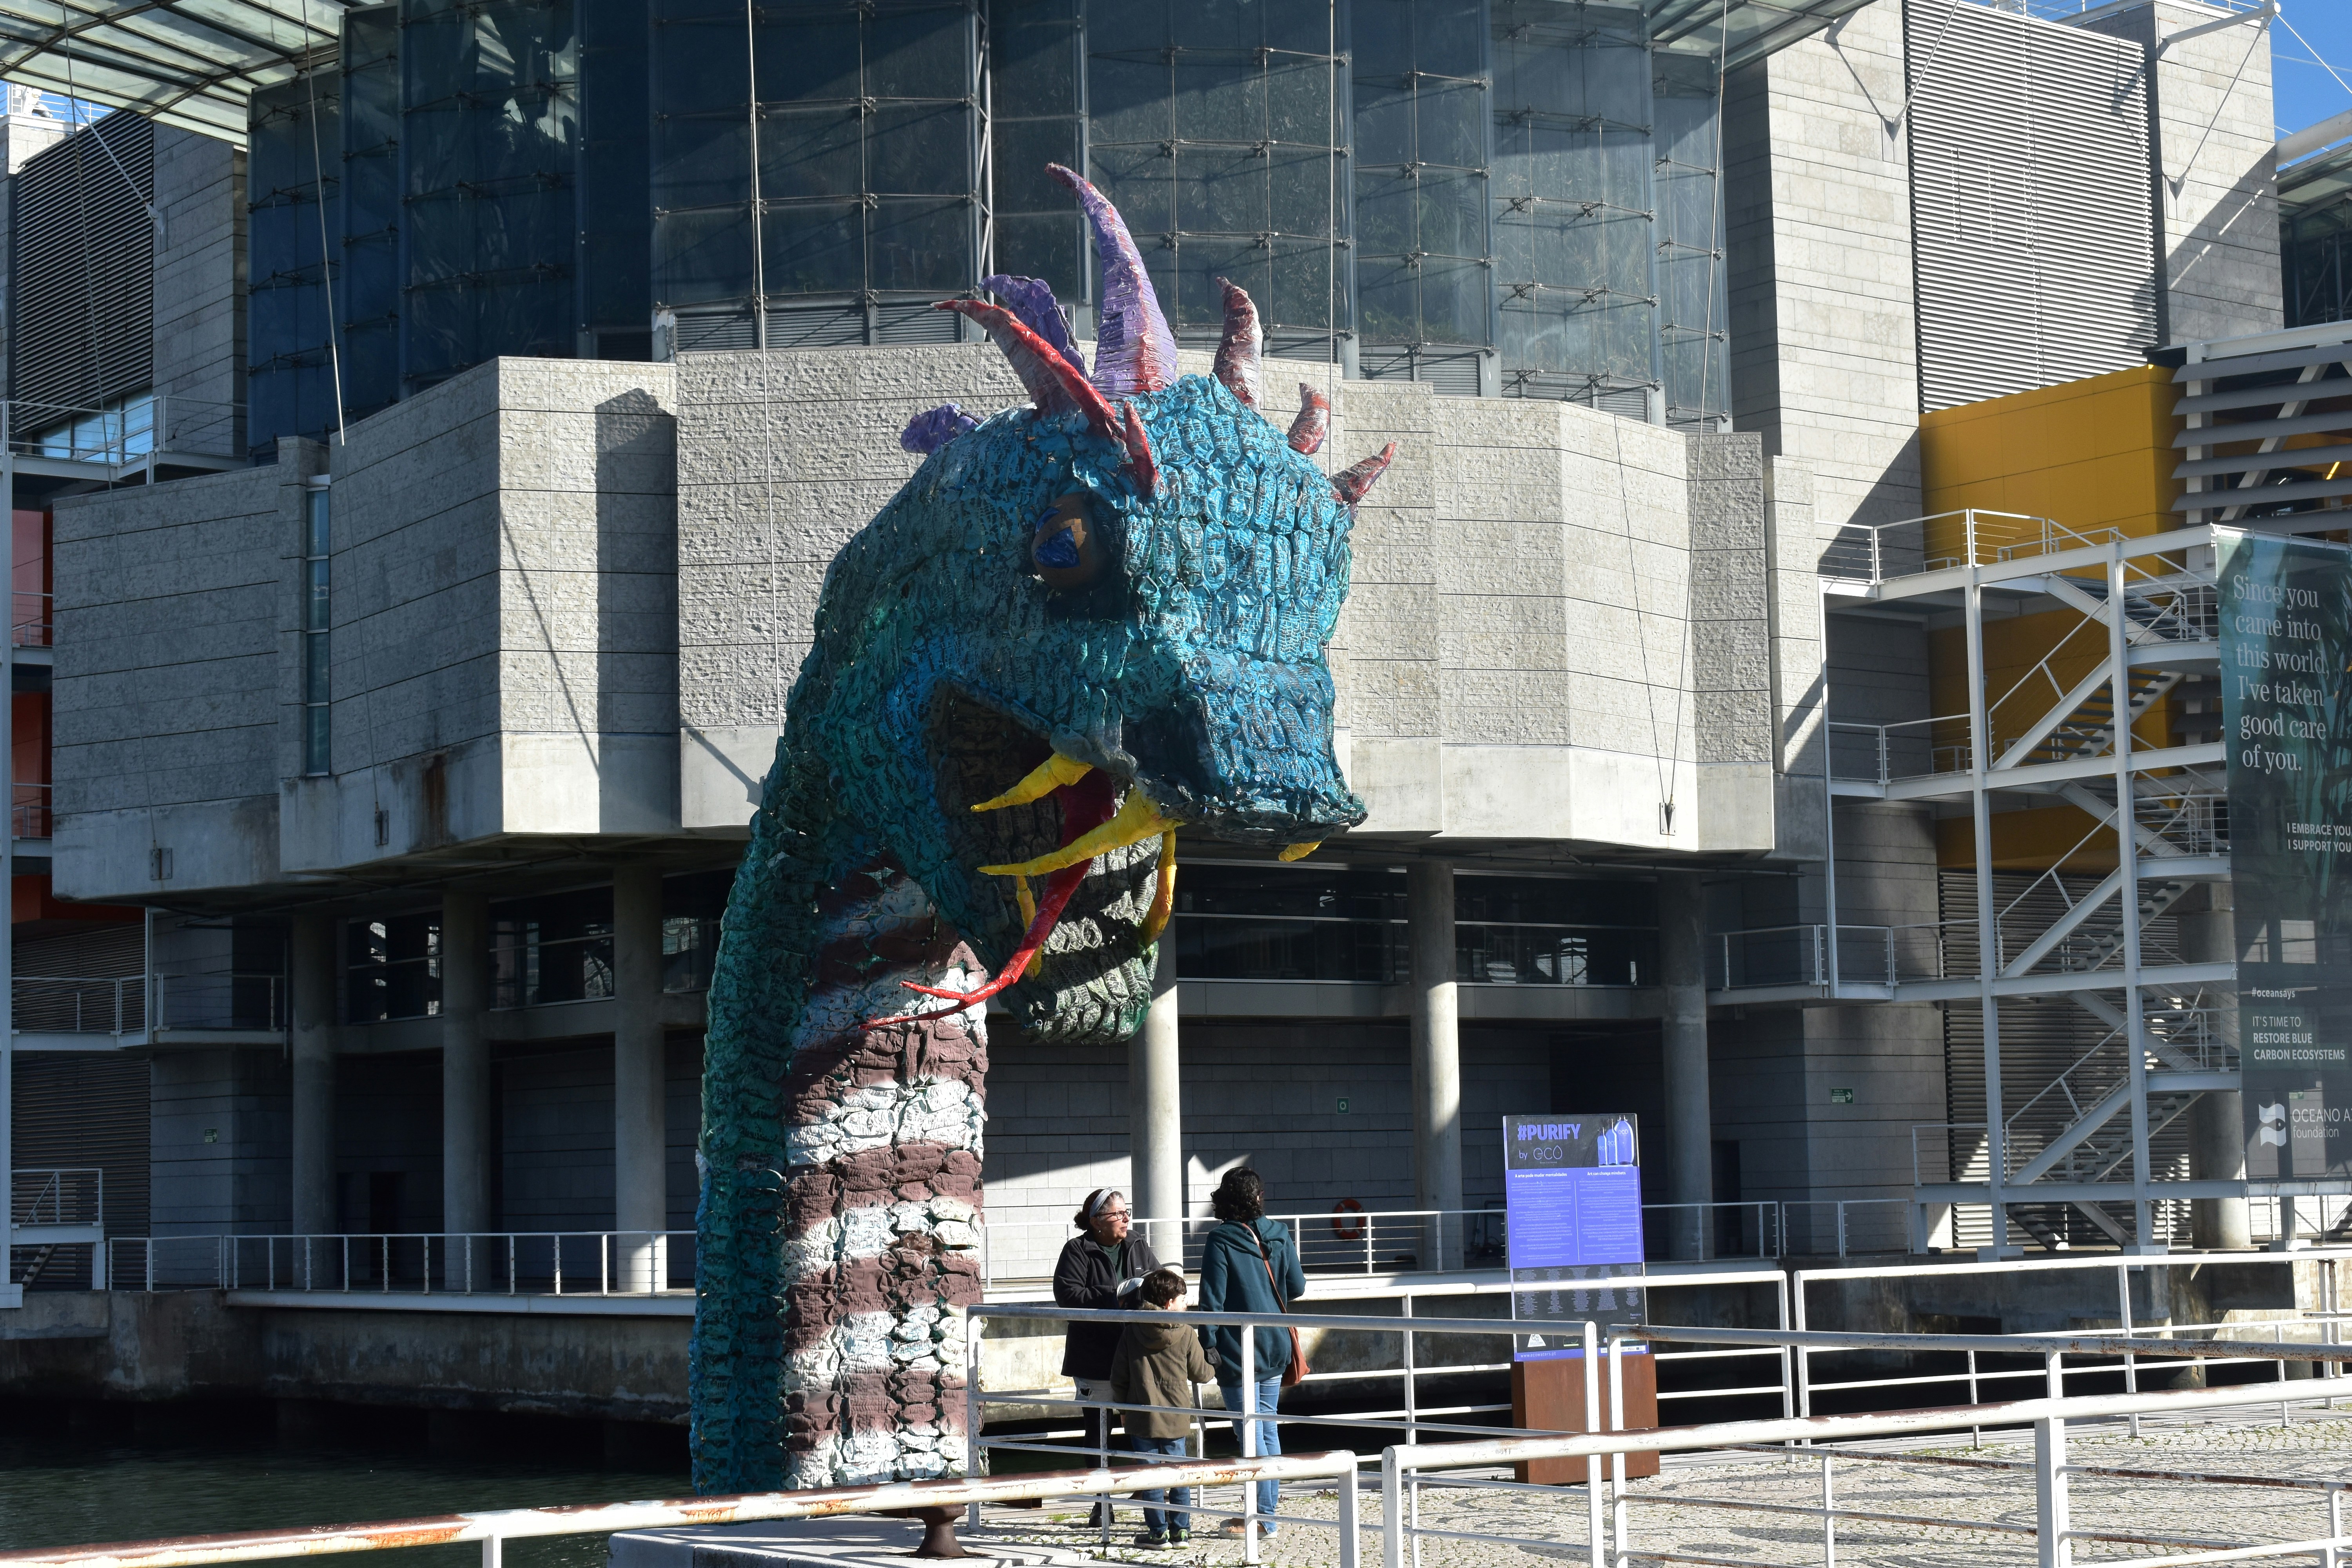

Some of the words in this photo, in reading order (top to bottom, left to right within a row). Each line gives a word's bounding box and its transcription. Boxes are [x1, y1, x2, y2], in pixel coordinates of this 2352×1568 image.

[2233, 574, 2281, 603] Since
[2286, 588, 2319, 610] you
[2236, 615, 2282, 637] came
[2287, 614, 2321, 641] into
[2236, 642, 2270, 668] this
[2274, 649, 2329, 680] world,
[2238, 675, 2270, 702] I've
[2274, 681, 2324, 706] taken
[2241, 713, 2284, 740] good
[2289, 720, 2326, 740] care
[2242, 744, 2261, 768] of
[2265, 752, 2301, 774] you.
[2287, 822, 2289, 833] I
[2292, 823, 2332, 835] EMBRACE
[2288, 839, 2290, 849] I
[2293, 839, 2331, 851] SUPPORT
[2333, 842, 2351, 853] YOU
[2251, 987, 2295, 1000] #oceansays
[2252, 1016, 2267, 1027] IT'S
[2269, 1016, 2288, 1027] TIME
[2290, 1016, 2301, 1027] TO
[2253, 1033, 2290, 1043] RESTORE
[2292, 1033, 2312, 1043] BLUE
[2254, 1049, 2290, 1060] CARBON
[2292, 1049, 2345, 1060] ECOSYSTEMS
[2292, 1108, 2340, 1122] OCEANO
[2343, 1108, 2352, 1122] A
[1517, 1124, 1581, 1140] #PURIFY
[2293, 1125, 2339, 1138] foundation
[1519, 1150, 1528, 1160] by
[1533, 1145, 1563, 1160] eco
